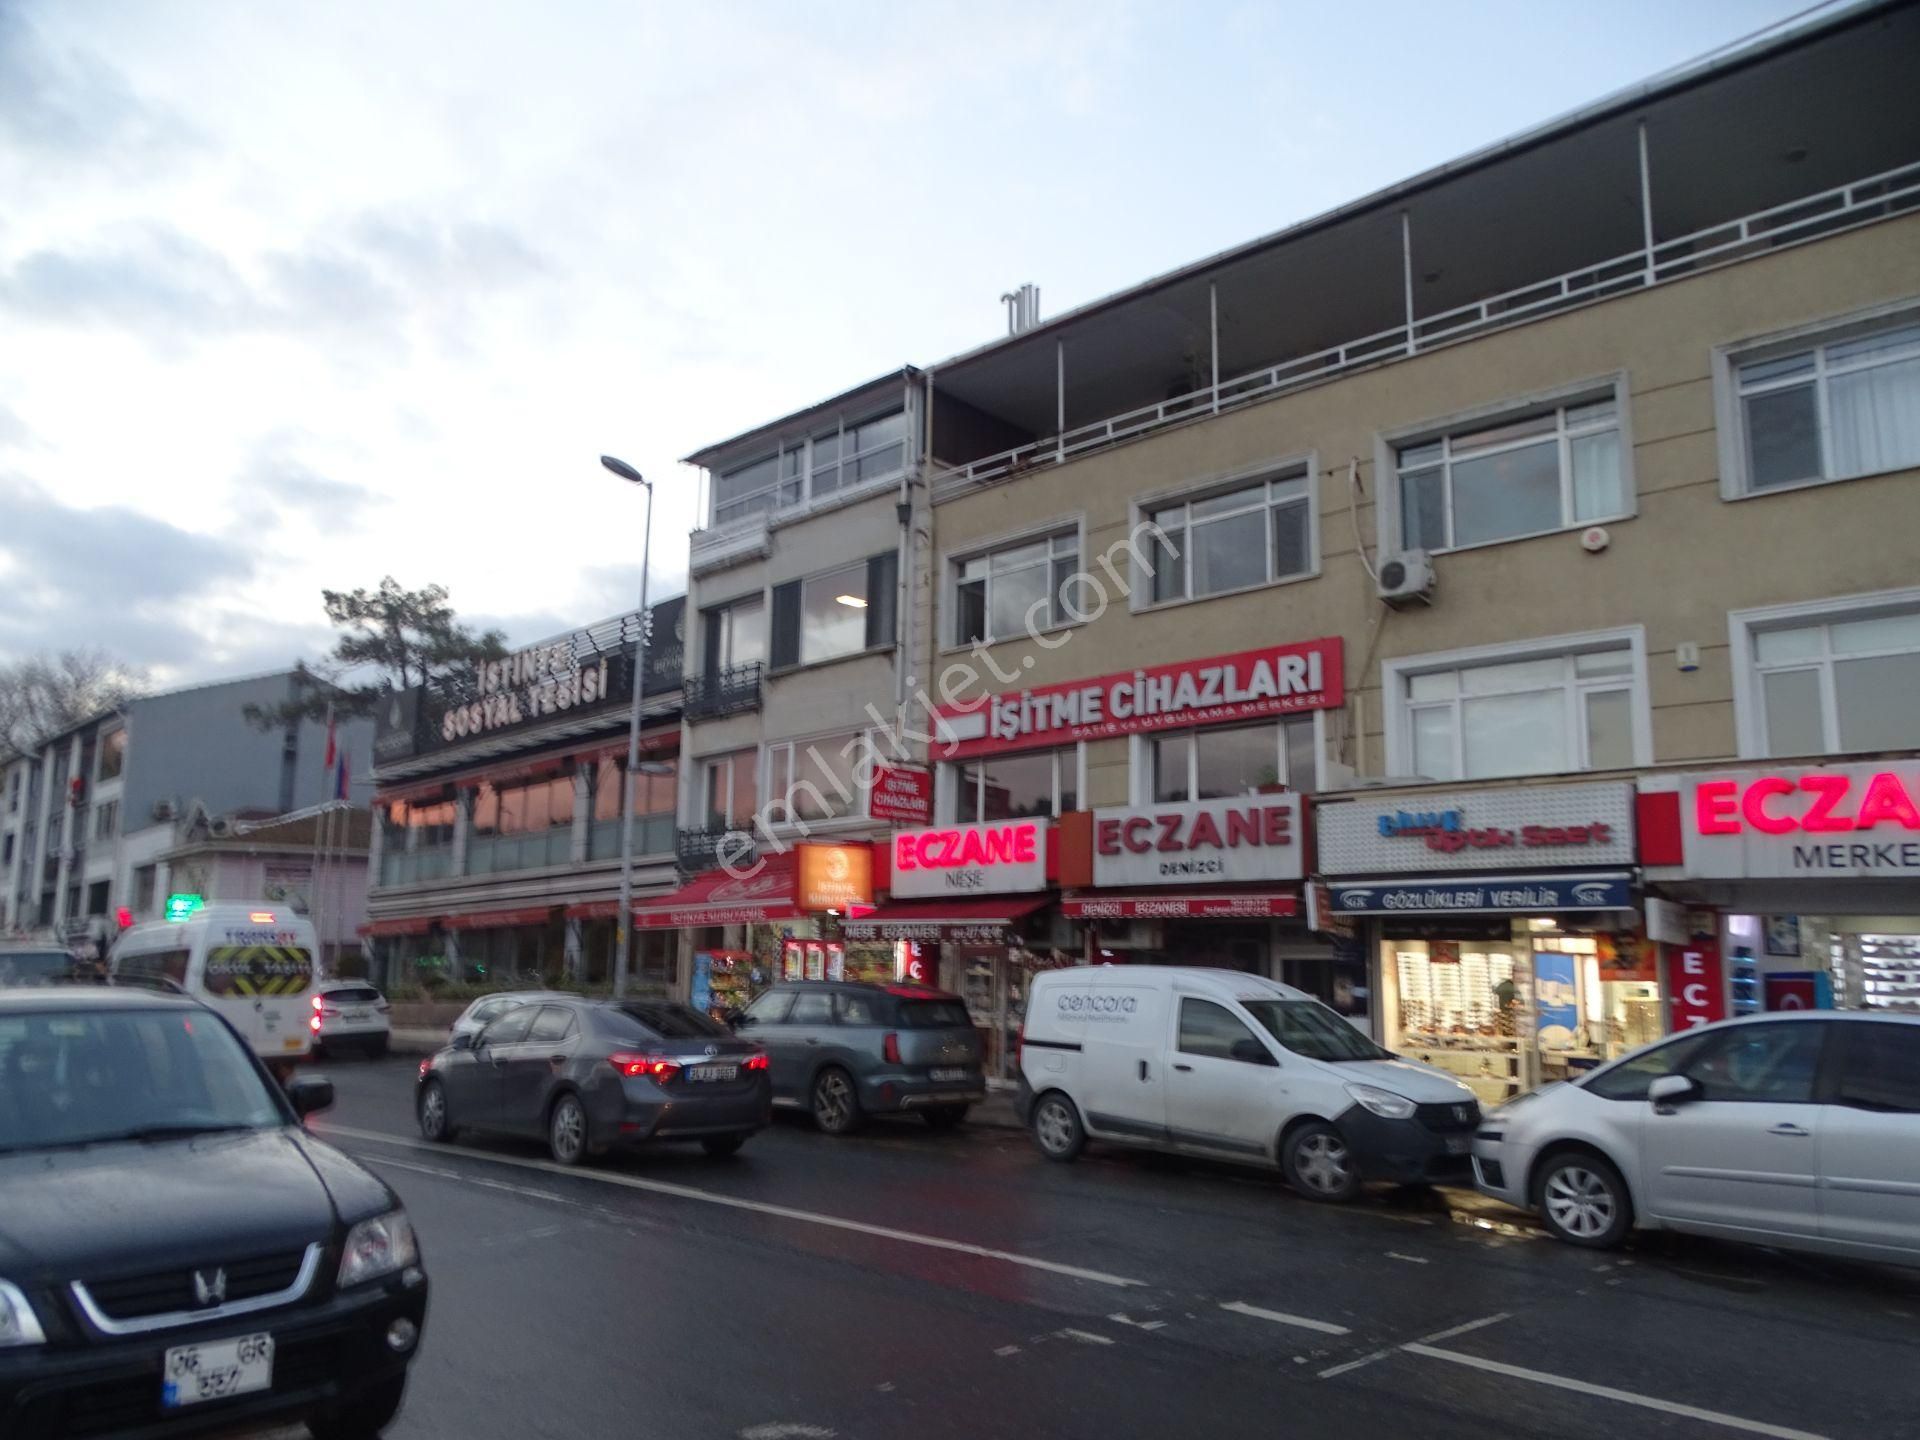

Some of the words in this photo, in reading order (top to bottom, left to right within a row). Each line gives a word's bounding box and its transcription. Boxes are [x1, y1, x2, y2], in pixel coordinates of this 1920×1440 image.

[443, 690, 523, 741] SOSYAL
[990, 685, 1104, 740] İŞİTME
[1109, 651, 1323, 719] CİHAZLARI
[1696, 772, 1920, 835] ECZA
[896, 823, 1037, 872] ECZANE
[1098, 805, 1292, 856] ECZANE
[945, 867, 985, 889] NEŞE
